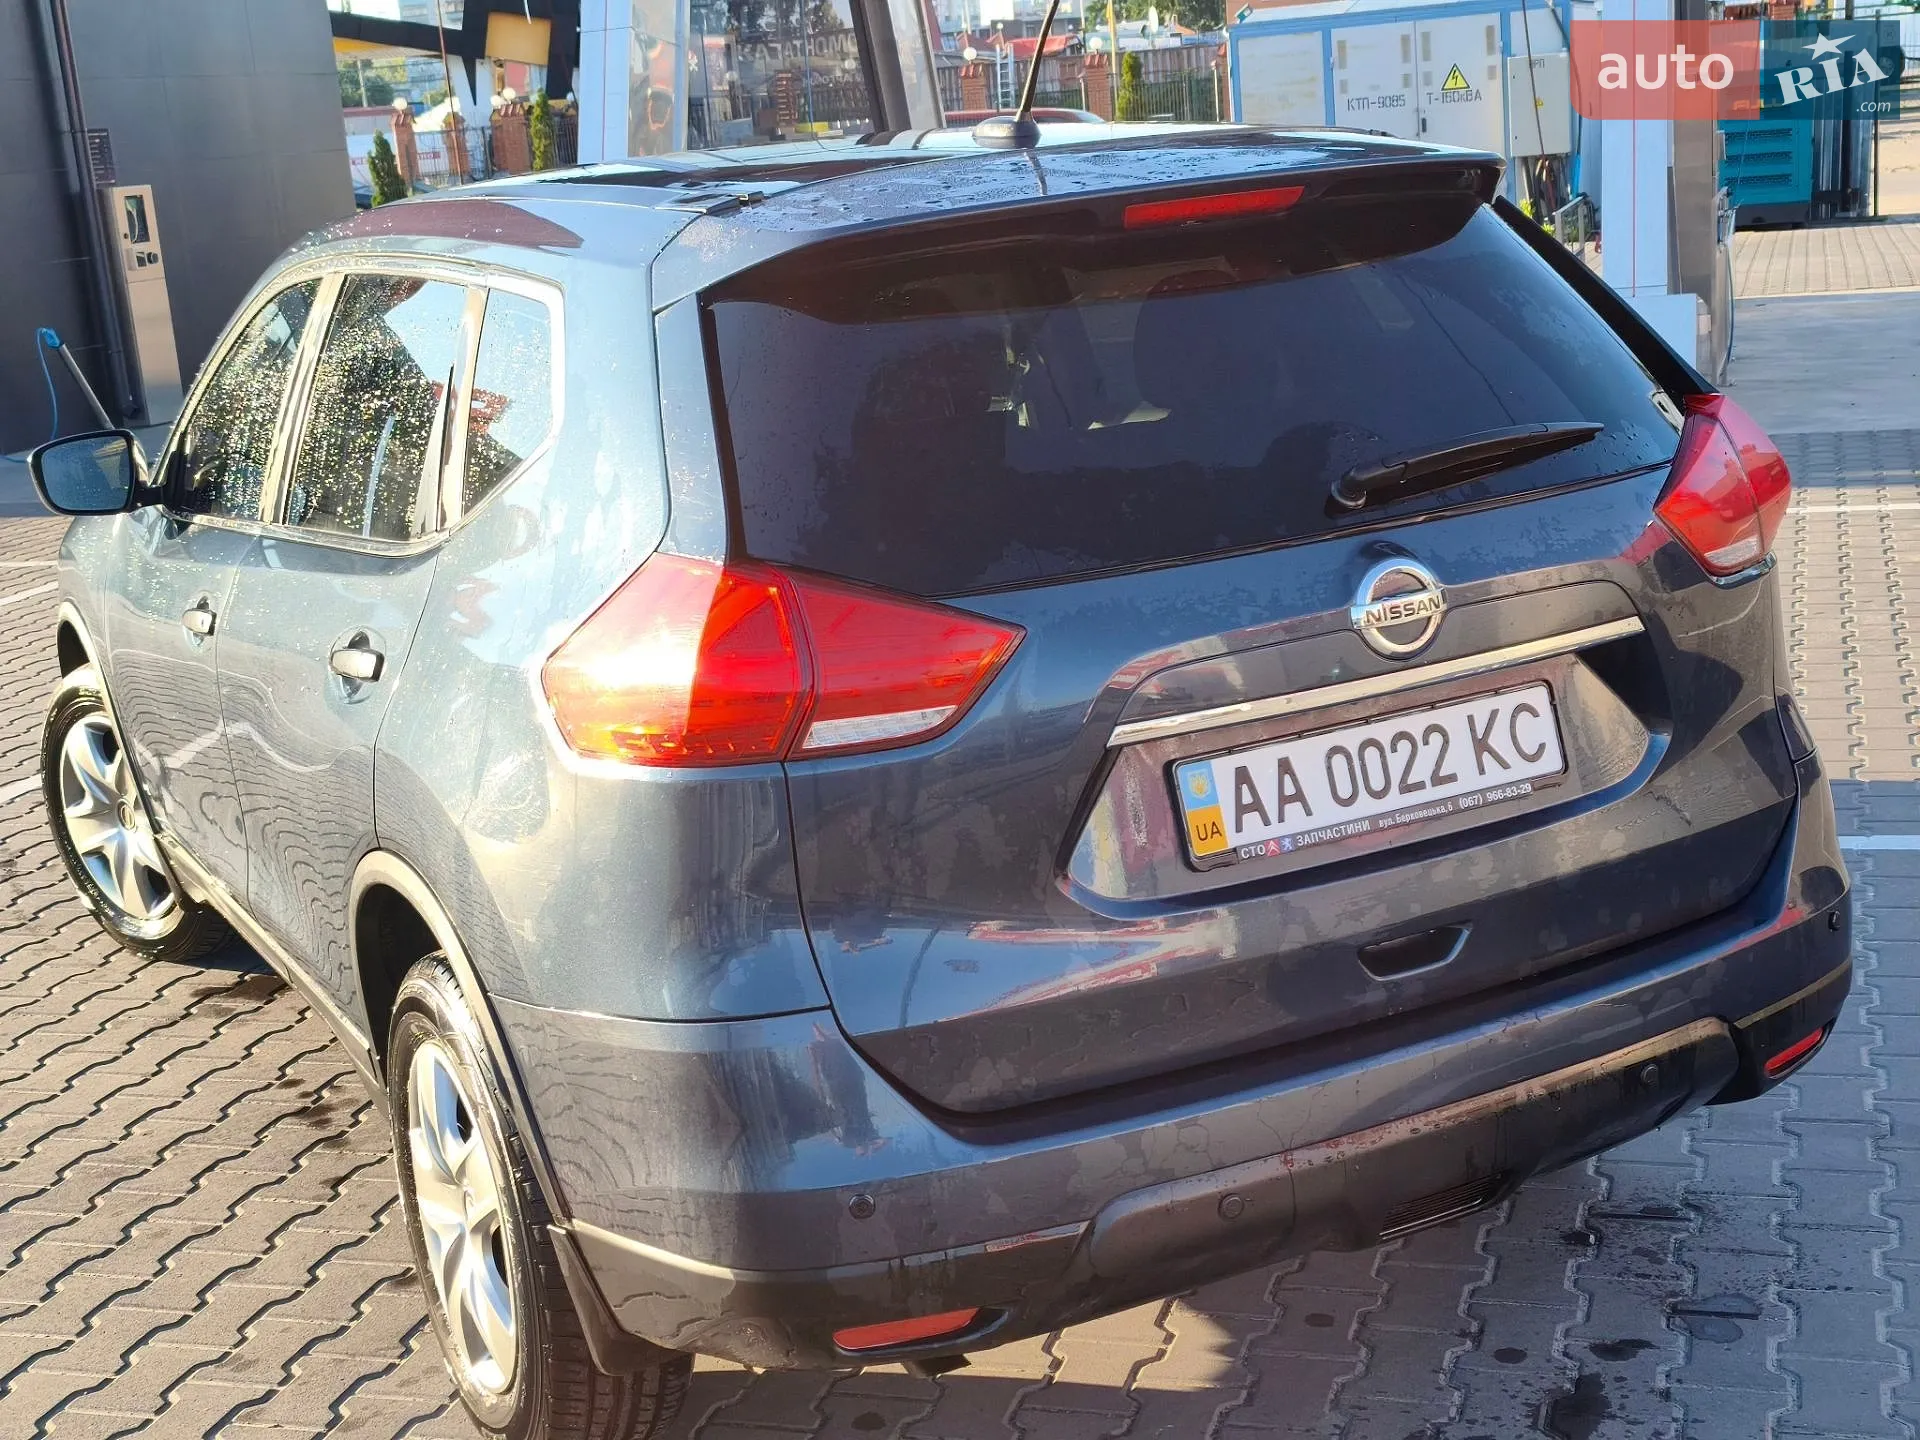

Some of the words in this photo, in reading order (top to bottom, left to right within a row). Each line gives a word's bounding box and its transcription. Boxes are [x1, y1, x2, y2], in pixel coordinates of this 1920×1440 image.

[1364, 594, 1441, 625] NISSAN
[1234, 756, 1314, 833] AA
[1325, 723, 1459, 808] 0022
[1467, 702, 1546, 777] KC
[1196, 821, 1222, 841] UA
[1241, 843, 1265, 859] СТО
[1296, 819, 1371, 847] ЗАПЧАСТИНИ
[1459, 794, 1483, 810] (067)
[1486, 783, 1532, 802] 966-83-29
